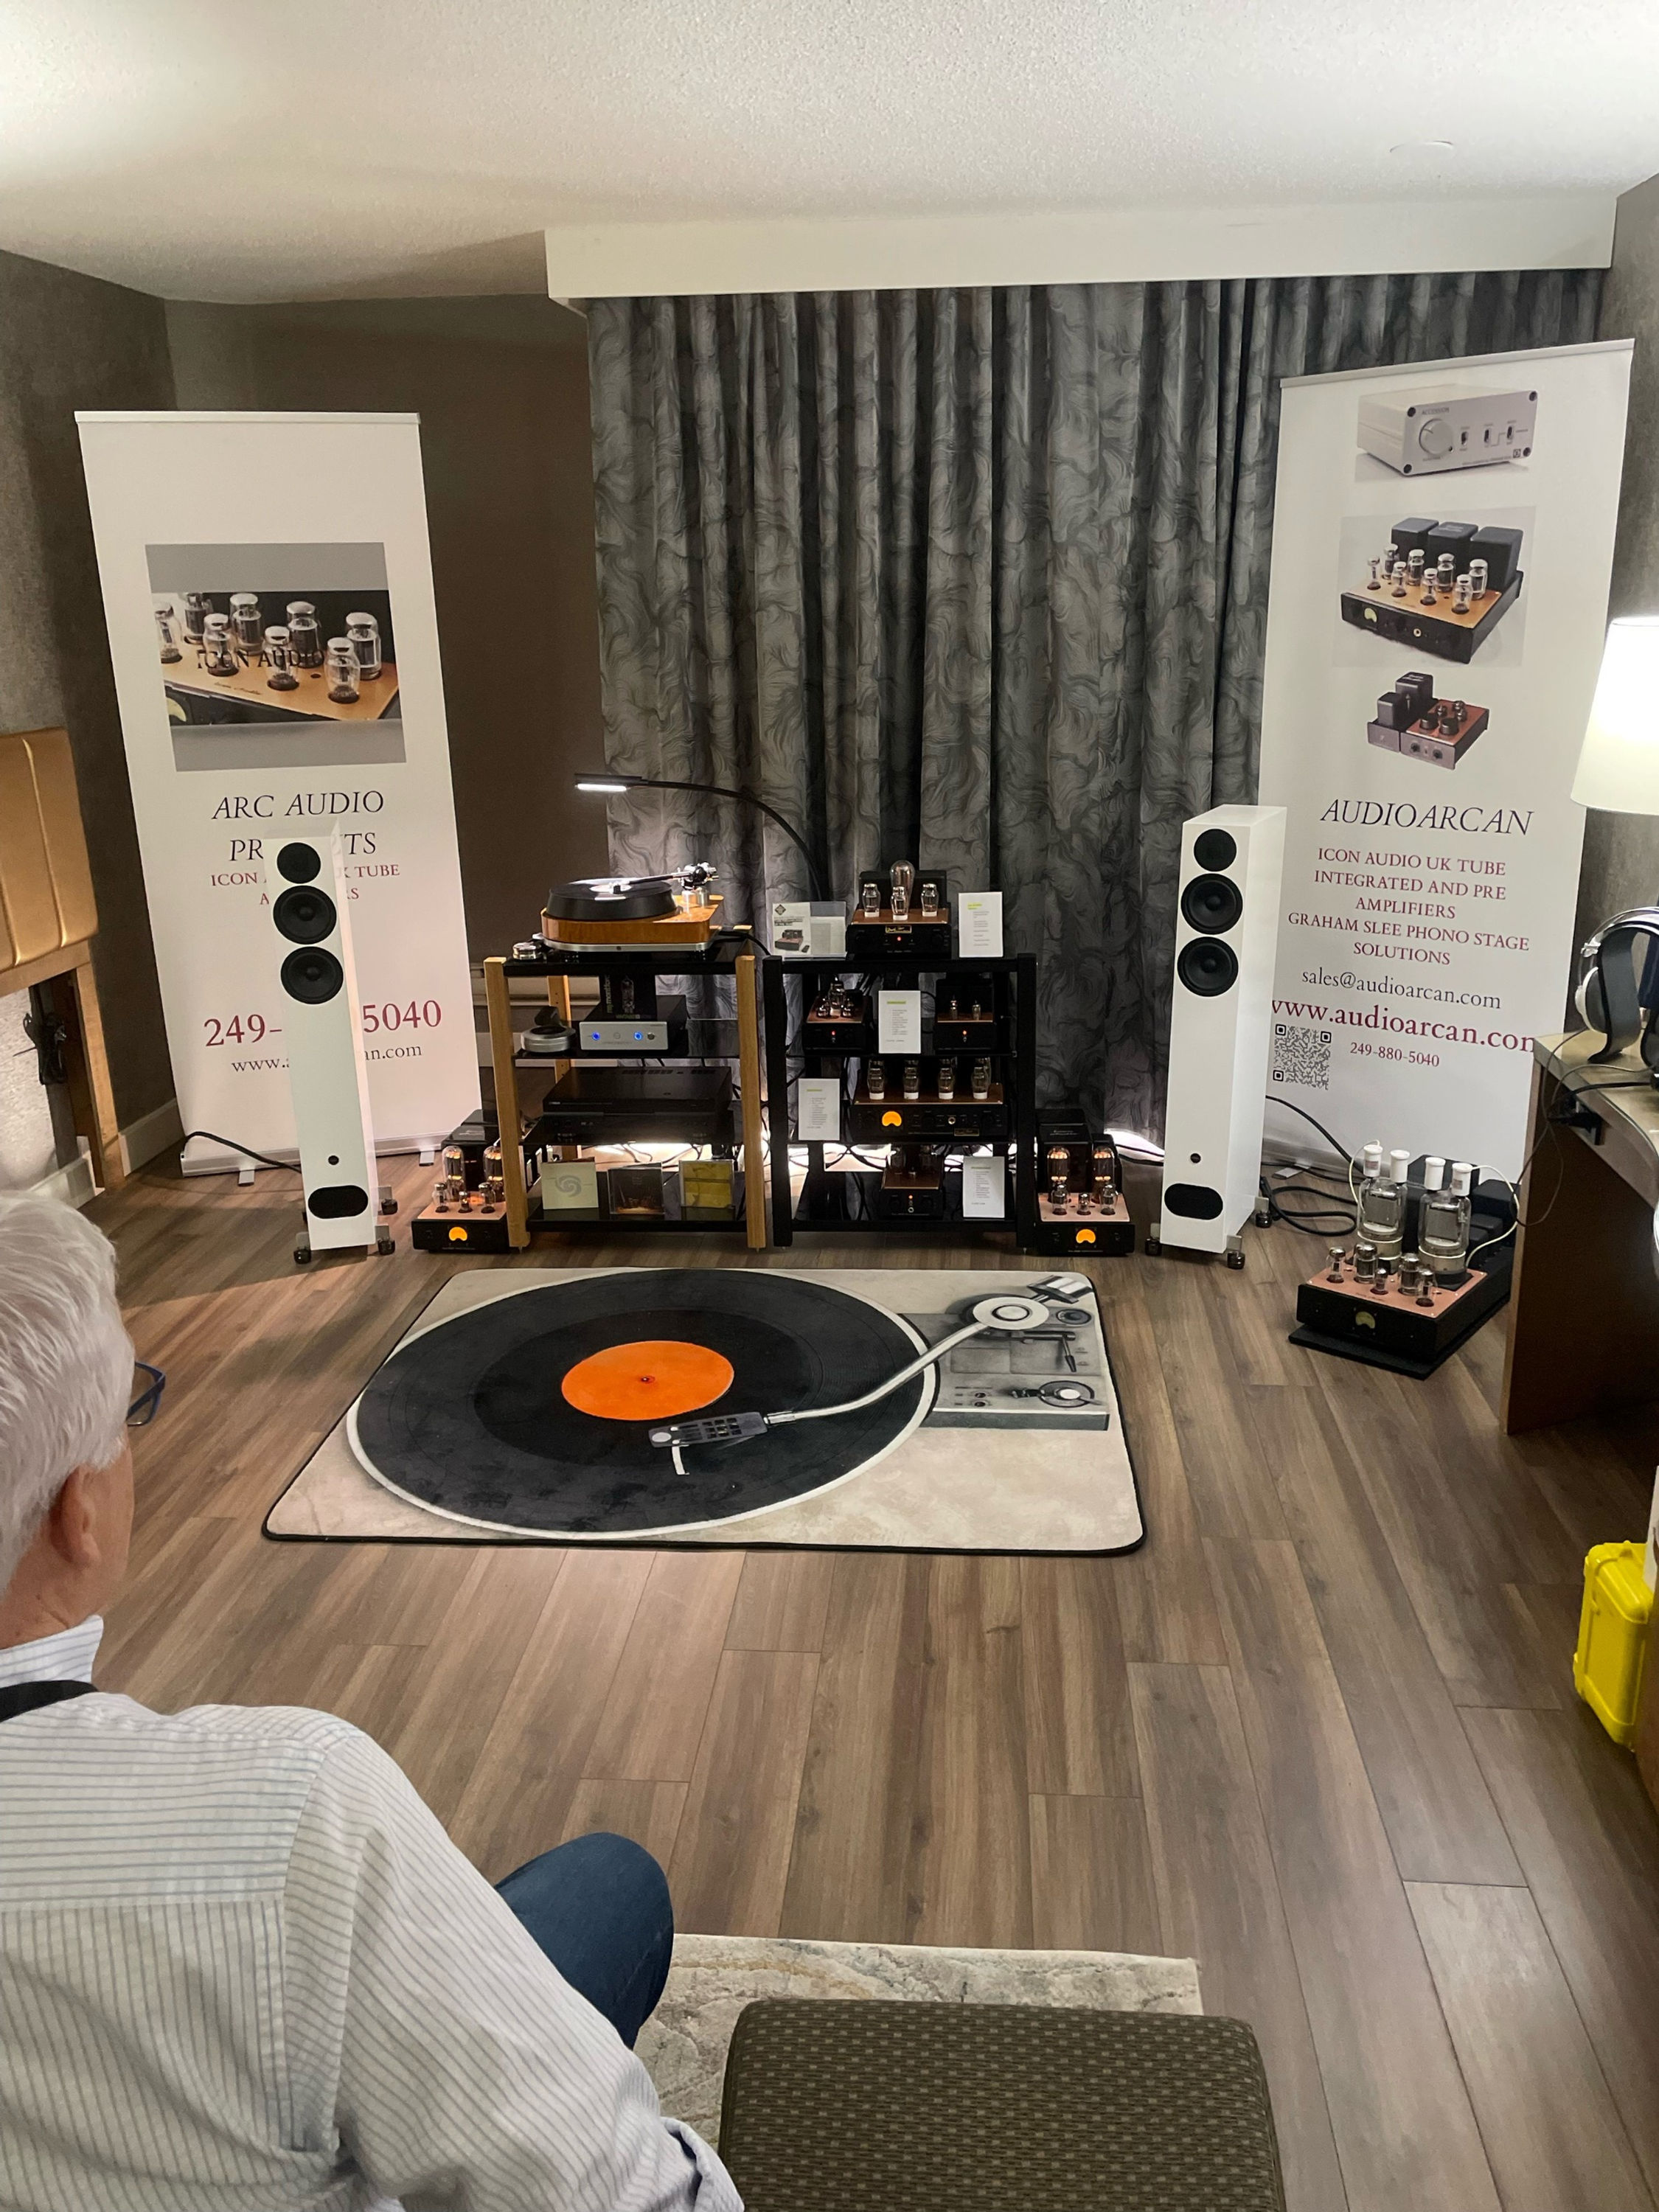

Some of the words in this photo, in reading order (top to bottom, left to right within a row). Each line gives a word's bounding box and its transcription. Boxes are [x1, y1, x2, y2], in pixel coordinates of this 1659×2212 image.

[211, 795, 274, 819] ARC
[285, 790, 383, 816] AUDIO
[1320, 799, 1534, 835] AUDIOARCAN
[211, 872, 257, 886] ICON
[354, 864, 400, 878] TUBE
[1318, 847, 1360, 863] ICON
[1365, 852, 1421, 868] AUDIO
[1426, 856, 1451, 871] UK
[1457, 859, 1506, 876] TUBE
[1315, 870, 1423, 891] INTEGRATED
[1427, 880, 1468, 896] AND
[1473, 884, 1506, 900] PRE
[1355, 897, 1456, 919] AMPLIFIERS
[1288, 912, 1359, 932] GRAHAM
[1363, 920, 1402, 936] SLEE
[1406, 925, 1469, 944] PHONO
[1474, 932, 1530, 951] STAGE
[1353, 942, 1450, 965] SOLUTIONS
[1301, 967, 1501, 1009] sales@audioarcan.com
[1349, 1042, 1440, 1068] 249-880-5040
